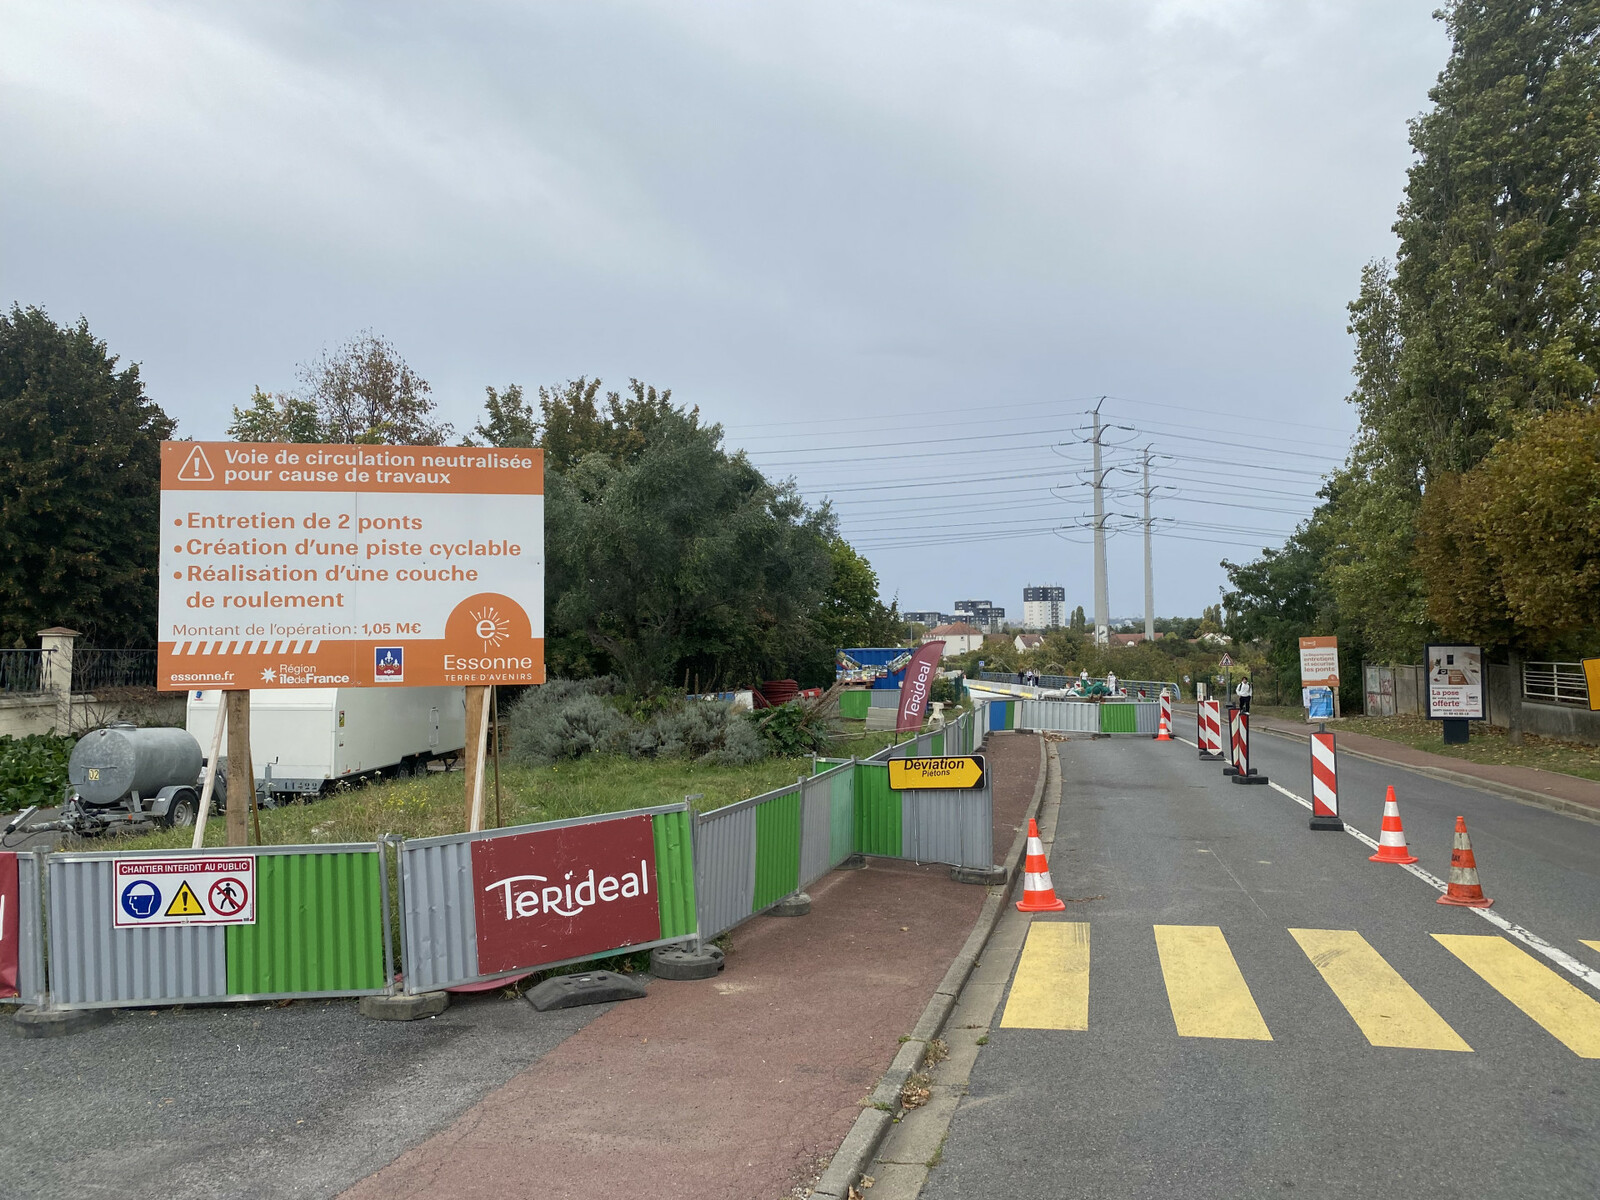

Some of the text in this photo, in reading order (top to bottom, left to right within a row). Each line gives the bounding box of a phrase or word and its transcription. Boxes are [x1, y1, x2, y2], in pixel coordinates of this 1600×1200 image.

[224, 449, 533, 469] Voie de circulation neutralisée
[224, 467, 451, 485] pour cause de travaux
[187, 512, 423, 534] Entretien de 2 ponts
[186, 538, 522, 559] Création d'une piste cyclable
[187, 564, 478, 582] Réalisation d'une couche
[186, 591, 344, 608] de roulement
[172, 624, 240, 636] Montant
[245, 623, 265, 635] de
[361, 623, 391, 637] 1,05
[396, 622, 422, 634] M€
[279, 664, 317, 675] Région
[444, 654, 533, 671] Essonne
[170, 670, 235, 682] essonne.fr
[444, 672, 533, 682] TERRE D'AVENIRS
[903, 758, 965, 771] Déviation
[921, 769, 951, 778] Piétons
[121, 862, 248, 874] CHANTIER INTERDIT AU PUBLIC
